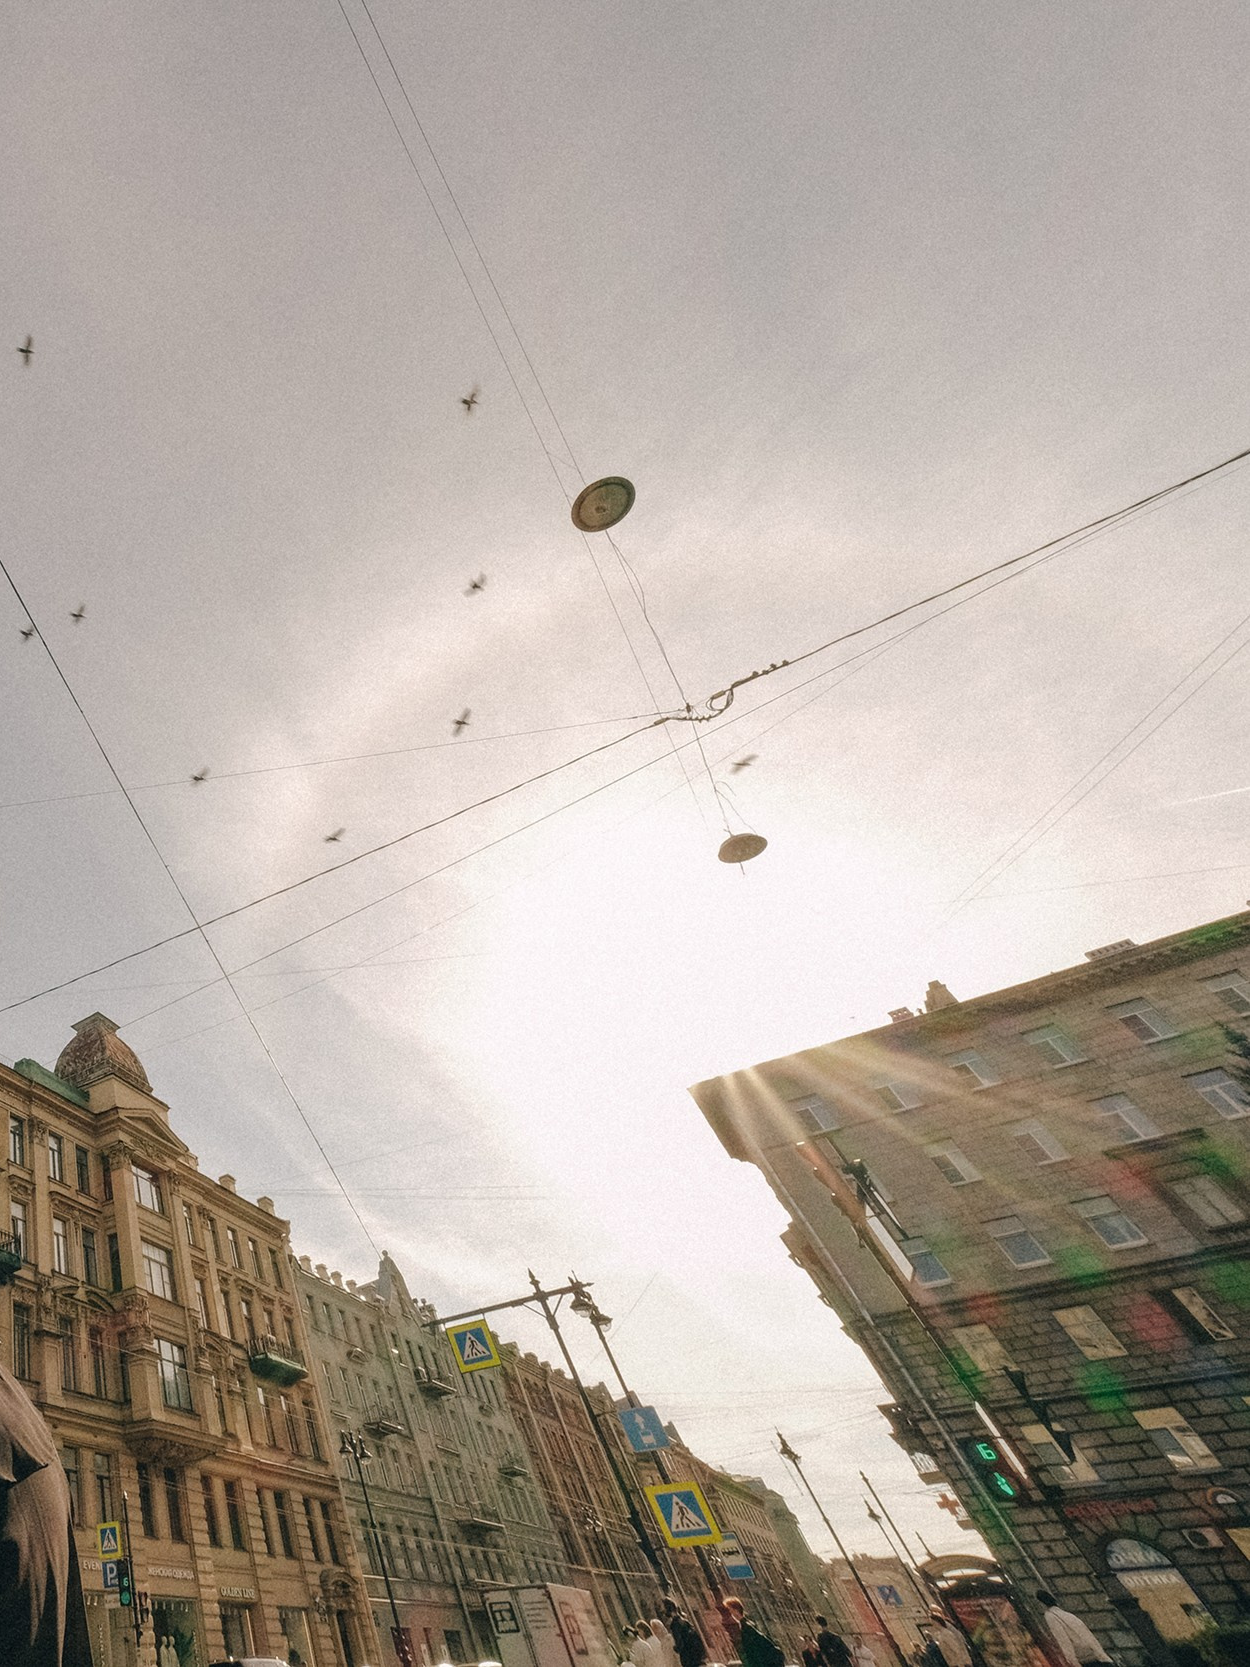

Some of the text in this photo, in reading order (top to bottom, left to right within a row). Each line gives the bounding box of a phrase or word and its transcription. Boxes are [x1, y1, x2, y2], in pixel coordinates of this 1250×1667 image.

[976, 1443, 996, 1460] 6
[123, 1577, 129, 1587] 6
[1124, 1573, 1181, 1588] ОПТИКА
[221, 1586, 242, 1598] GOLDEN
